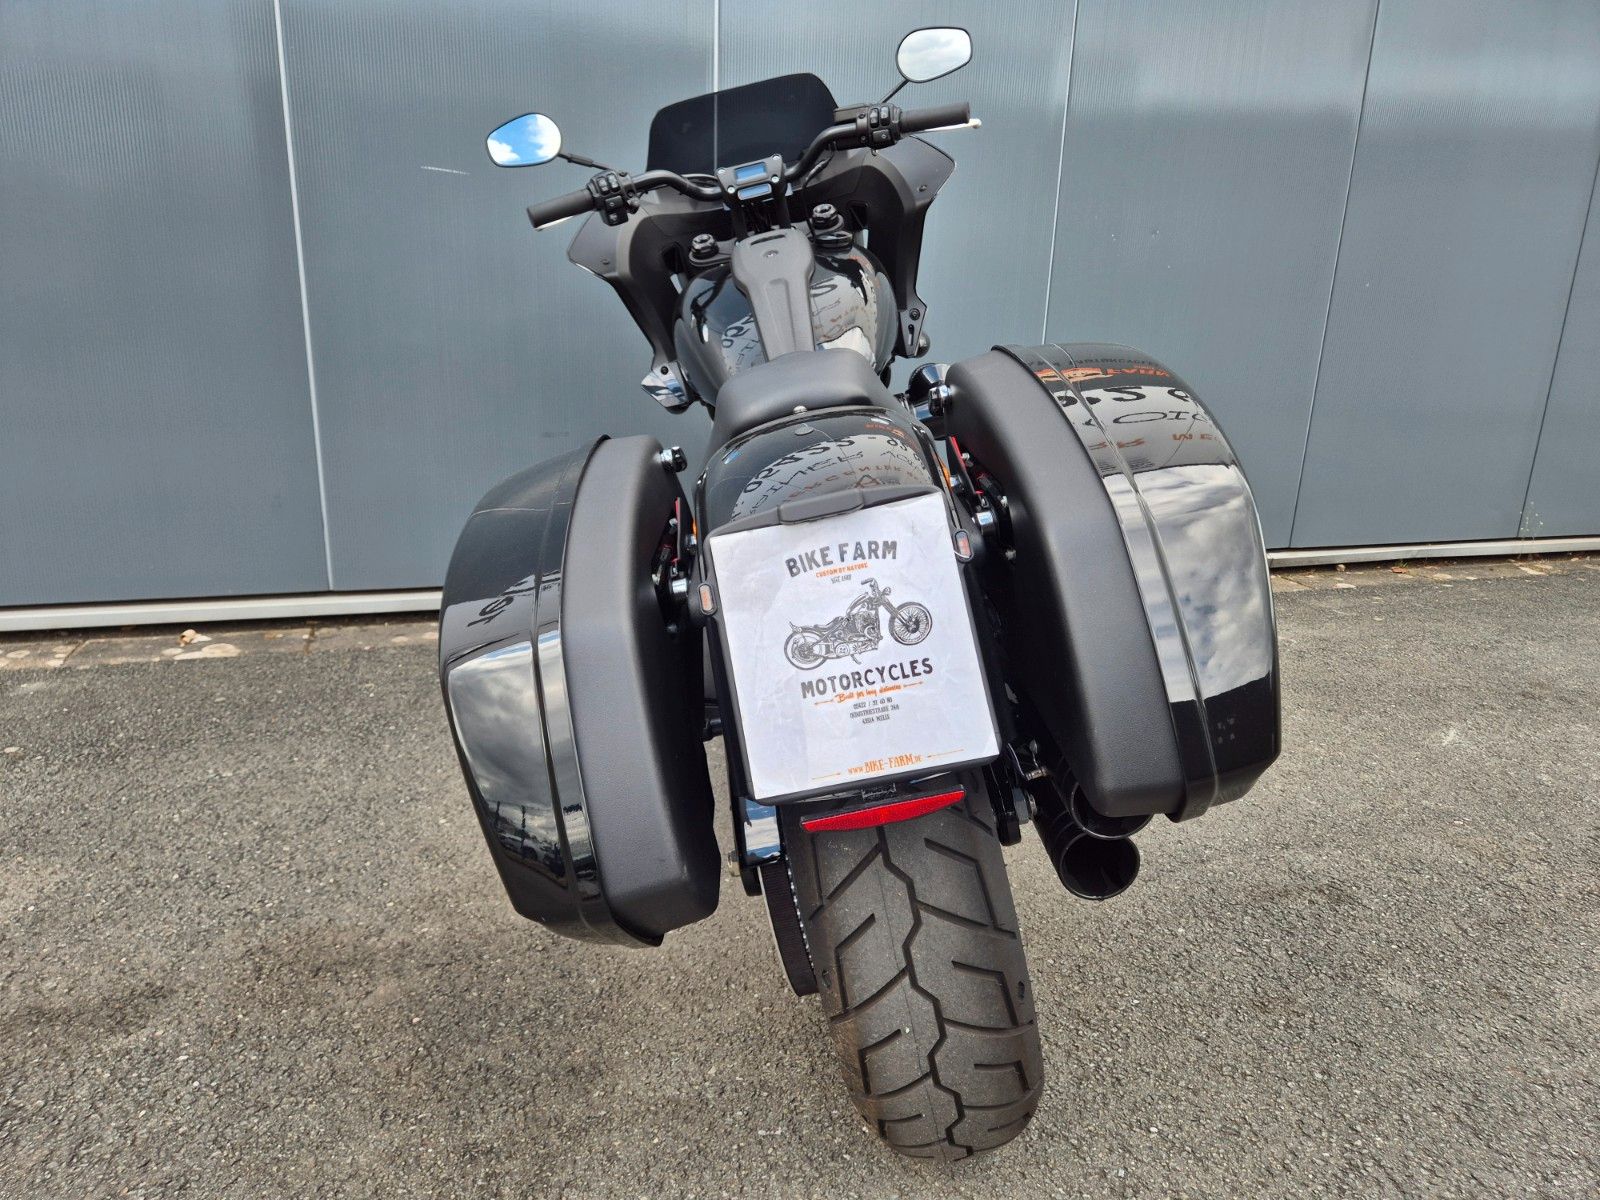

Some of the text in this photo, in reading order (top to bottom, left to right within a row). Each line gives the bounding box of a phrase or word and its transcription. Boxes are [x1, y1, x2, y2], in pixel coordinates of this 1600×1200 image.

[785, 540, 898, 577] BIKE FARM
[801, 657, 933, 699] MOTORCYCLES
